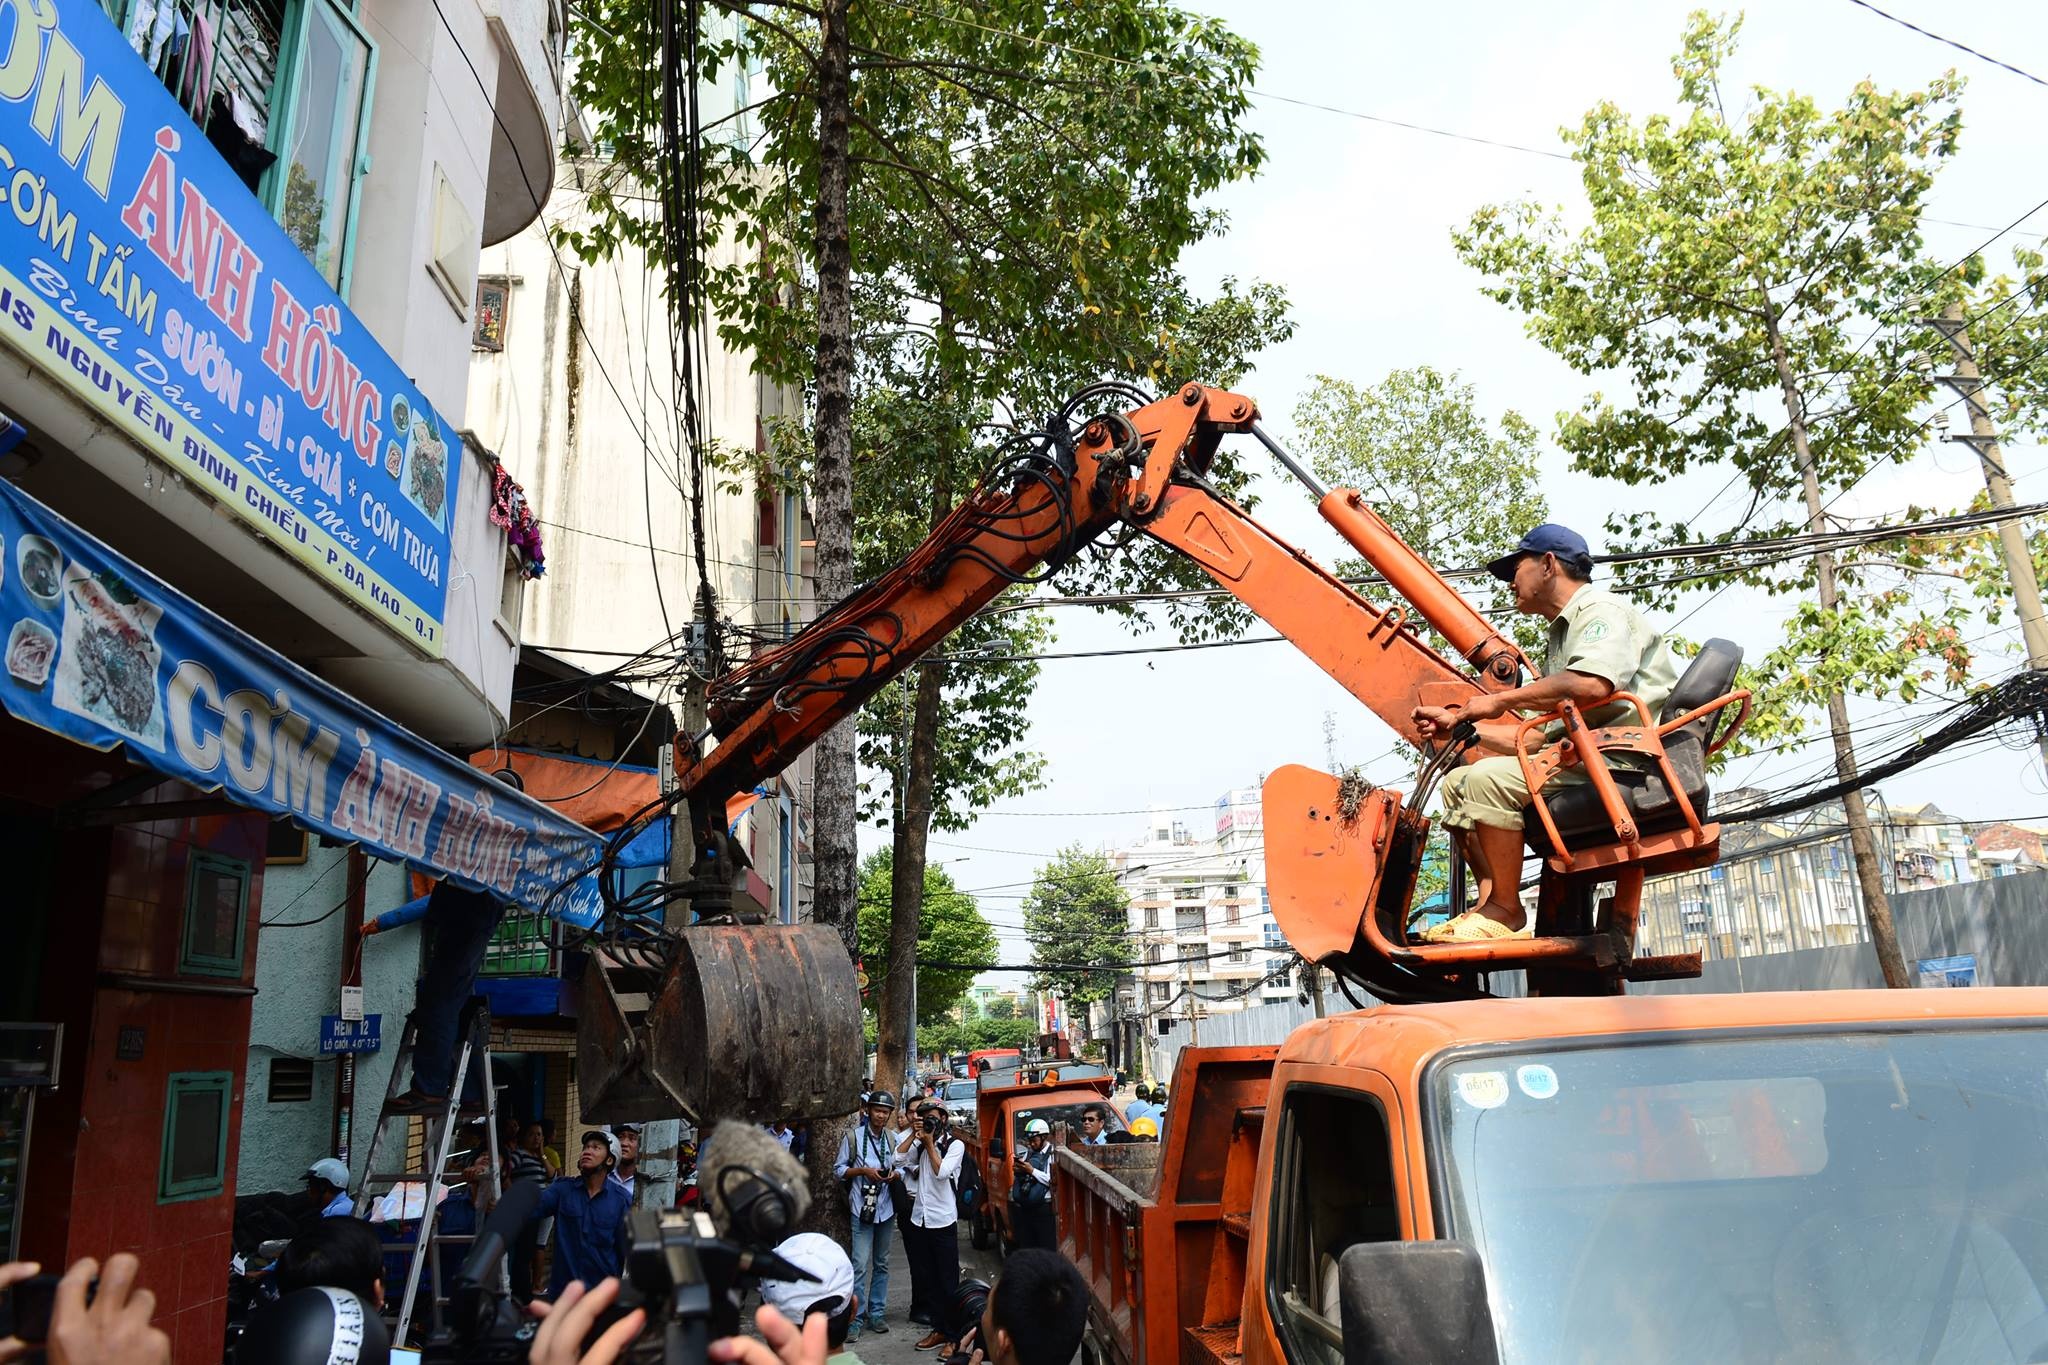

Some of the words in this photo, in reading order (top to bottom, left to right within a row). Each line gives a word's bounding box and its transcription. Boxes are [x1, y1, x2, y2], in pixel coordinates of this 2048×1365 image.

[29, 257, 122, 351] Bình
[134, 348, 202, 420] Dân
[244, 441, 306, 505] Kính
[314, 499, 360, 551] Mời
[87, 229, 158, 337] TẤM
[162, 308, 243, 414] SƯỜN
[258, 394, 284, 451] BÌ
[299, 435, 342, 505] CHẢ
[360, 492, 400, 552] CƠM
[402, 527, 439, 587] TRƯA
[121, 125, 263, 344] ẢNH
[261, 278, 382, 467] HỒNG
[46, 325, 173, 442] NGUYỄN
[183, 435, 238, 492] ĐÌNH
[245, 485, 308, 544] CHIỂU
[371, 582, 400, 616] KAO
[415, 617, 434, 642] Q.1
[167, 659, 341, 823] CƠM
[332, 727, 442, 860] ẢNH
[431, 787, 529, 895] HỒNG
[360, 1020, 369, 1036] 12
